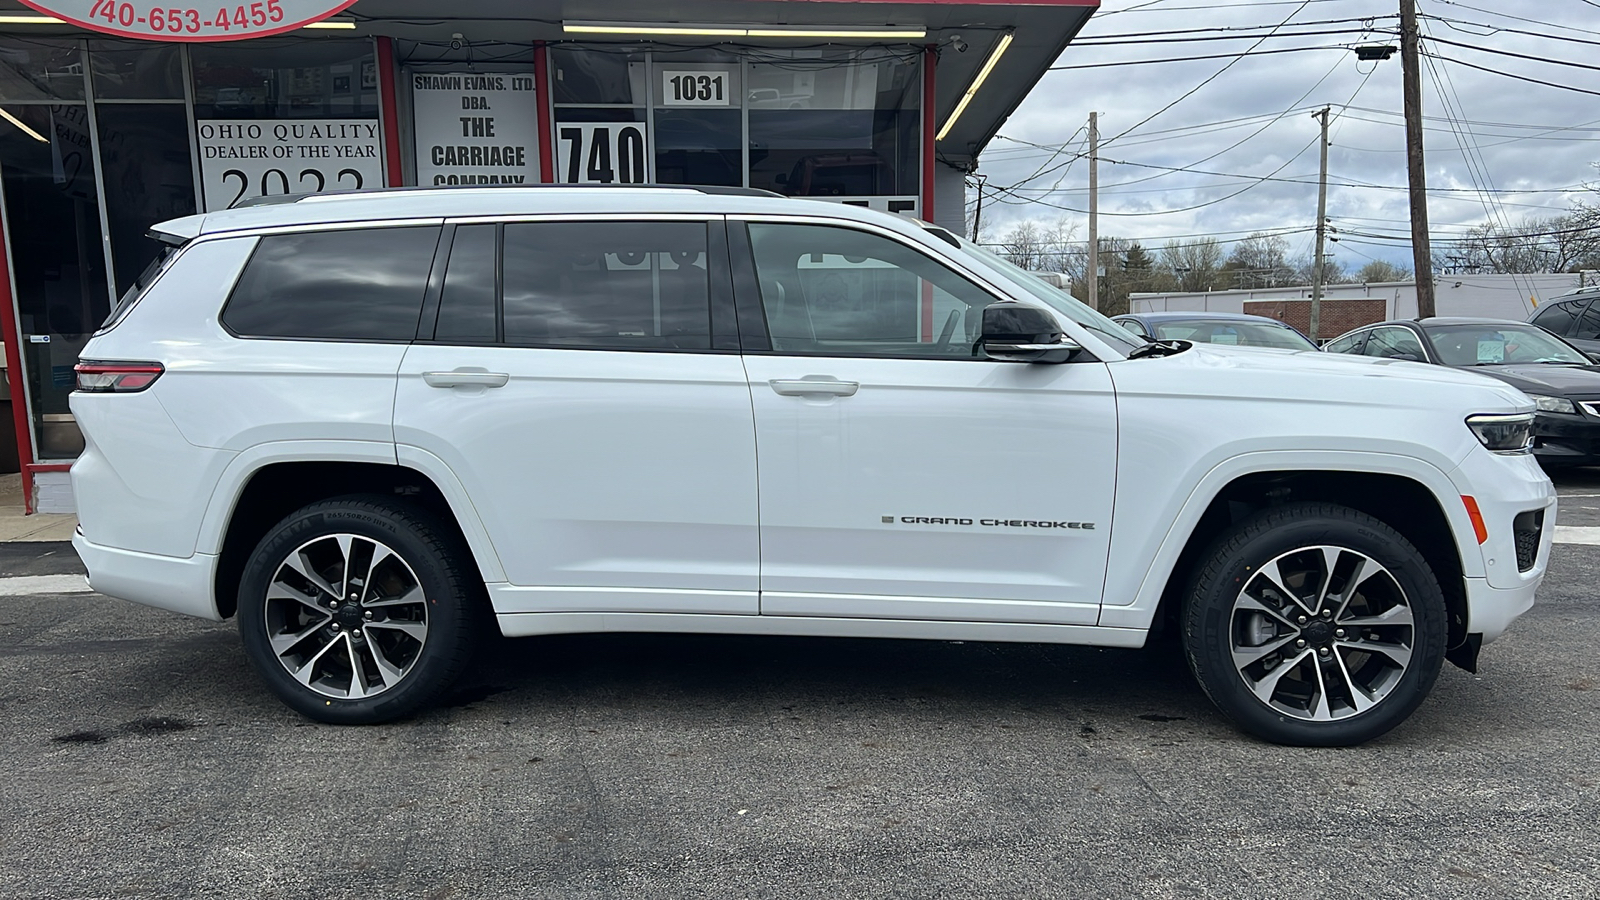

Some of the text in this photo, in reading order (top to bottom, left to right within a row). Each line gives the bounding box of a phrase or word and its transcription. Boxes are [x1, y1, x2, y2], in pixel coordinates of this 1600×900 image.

[89, 0, 284, 33] 740-653-4455
[415, 76, 536, 91] SHAWN EVANS. LTD.
[670, 75, 723, 101] 1031
[462, 96, 491, 110] DBA.
[200, 124, 377, 141] OHIO QUALITY
[460, 117, 495, 137] THE
[204, 145, 377, 159] DEALER OF THE YEAR
[431, 145, 526, 167] CARRIAGE
[560, 126, 645, 184] 740
[901, 516, 1096, 530] GRAND CHEROKEE
